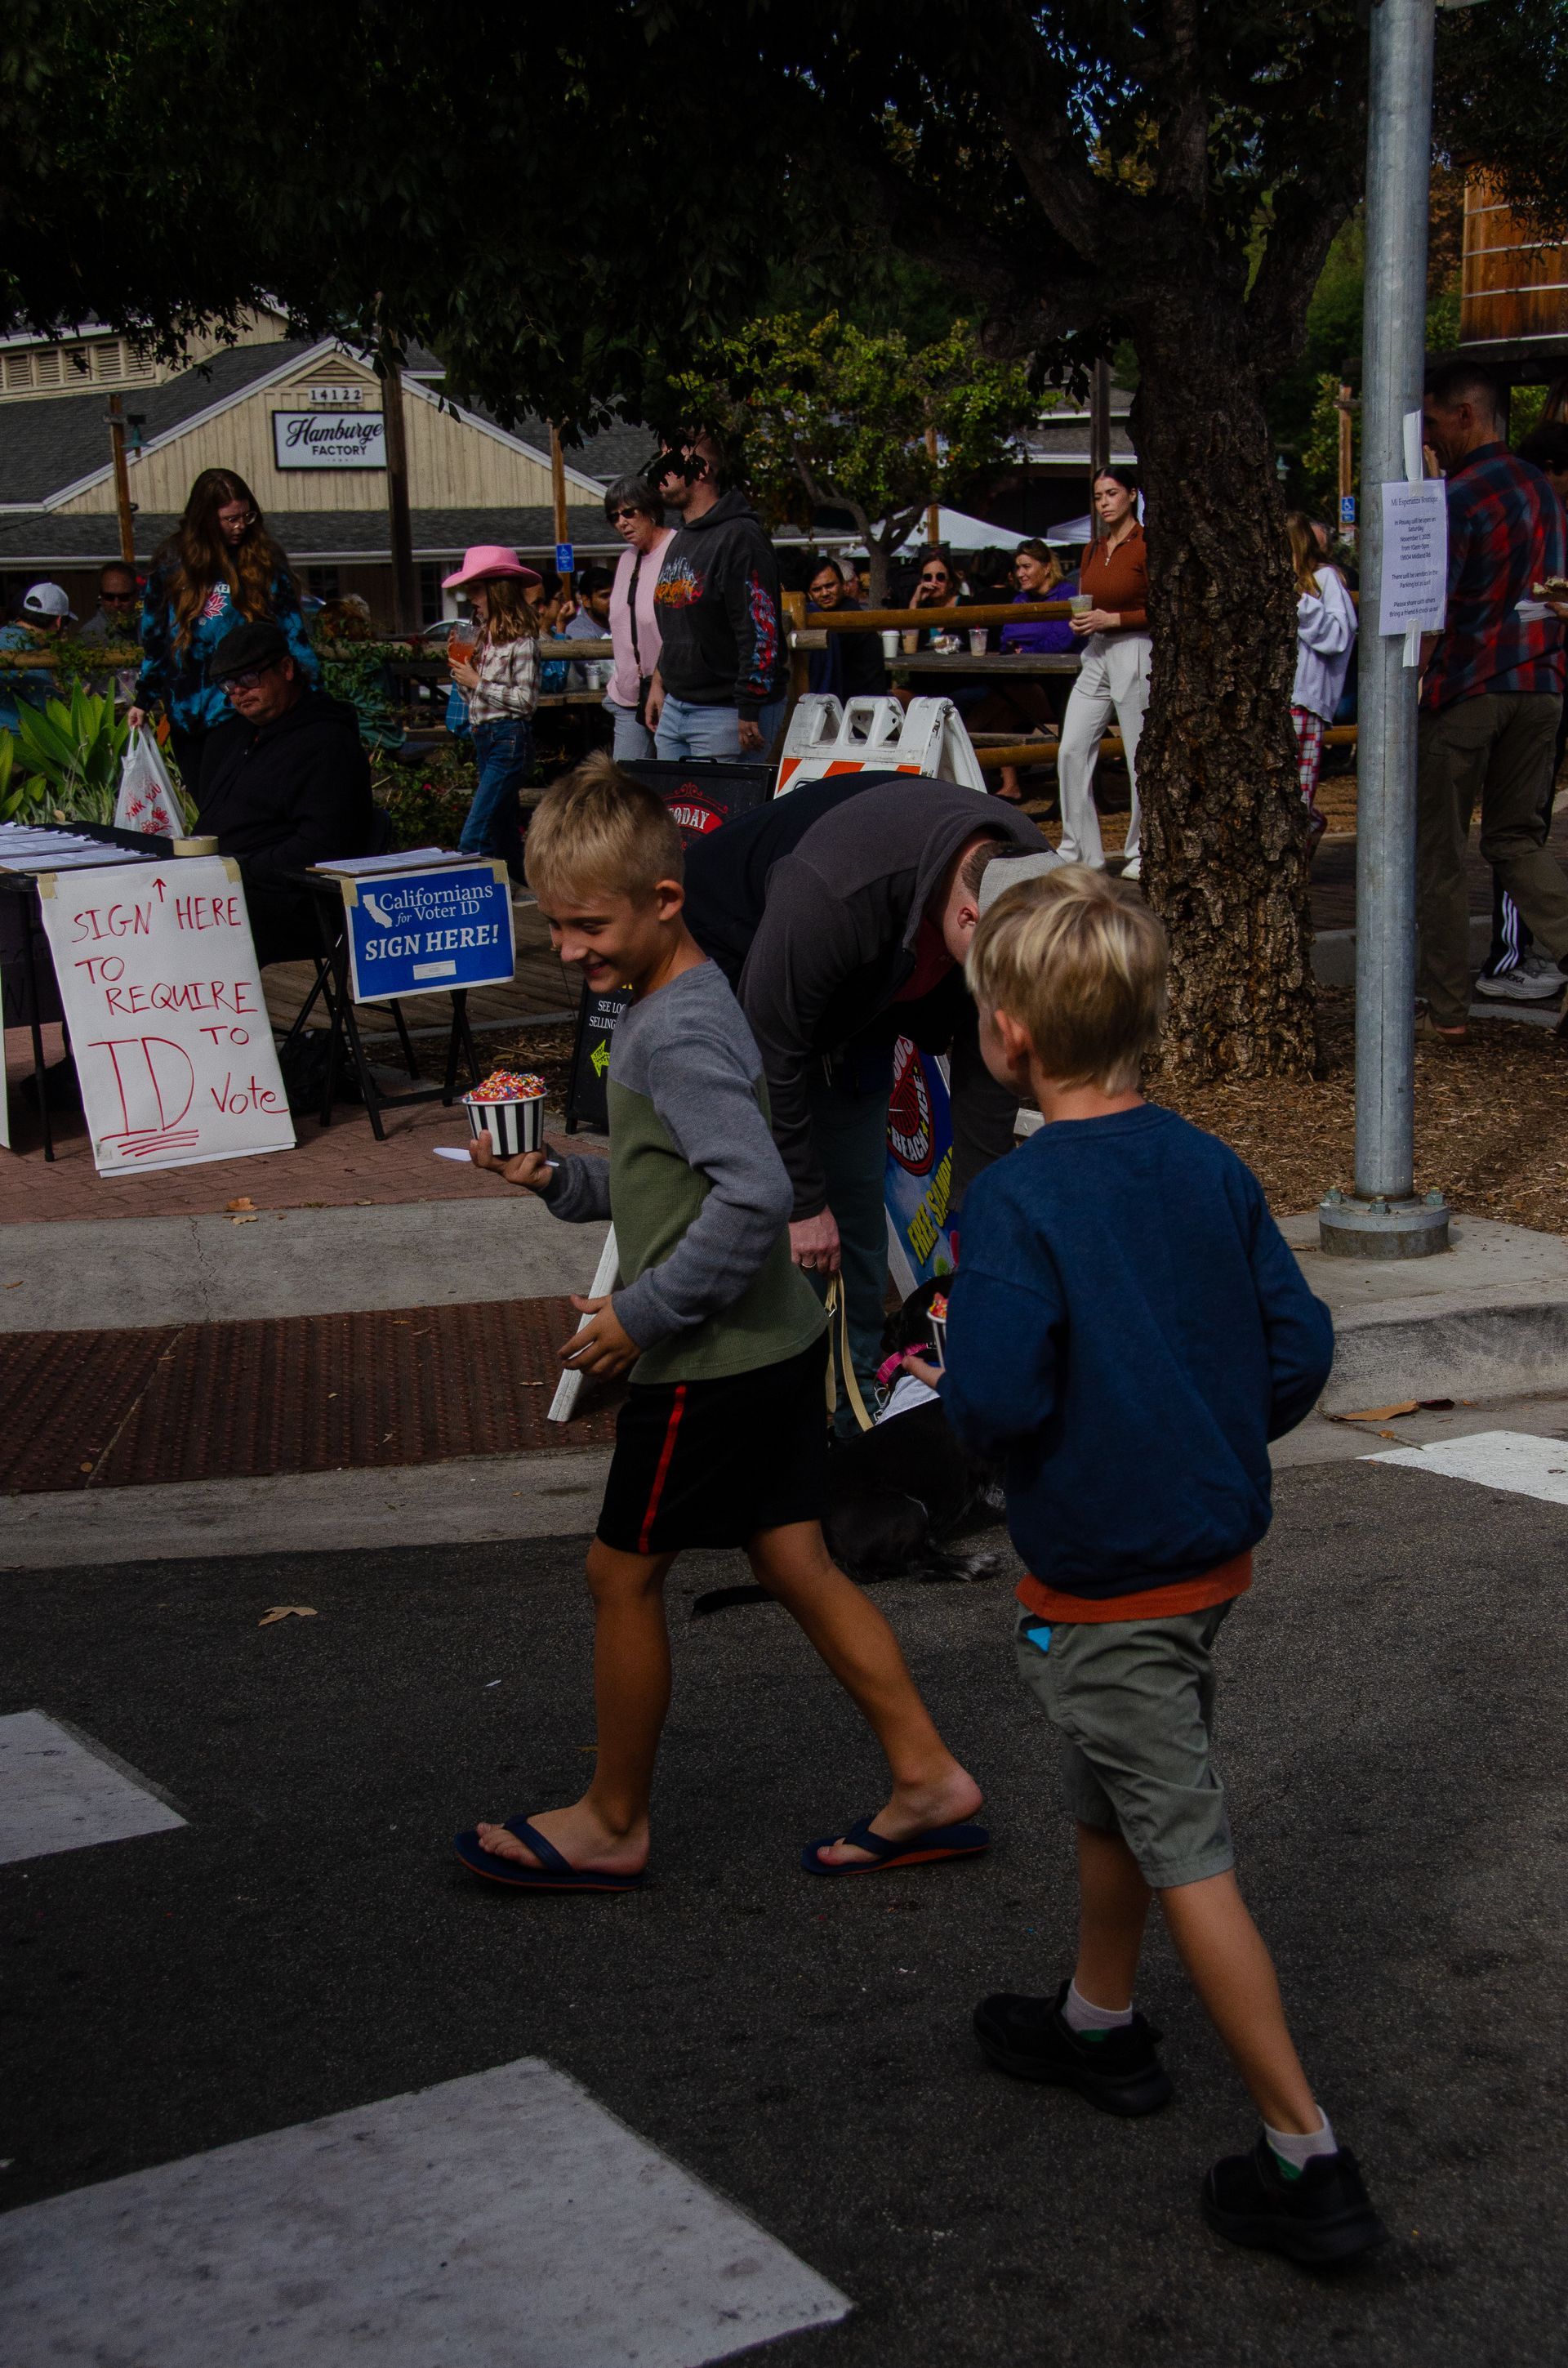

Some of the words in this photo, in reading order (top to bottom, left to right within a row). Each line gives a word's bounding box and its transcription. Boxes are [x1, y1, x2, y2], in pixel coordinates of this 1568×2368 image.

[310, 389, 362, 400] 14122
[286, 416, 385, 448] Hamburge
[312, 445, 367, 455] FACTORY
[380, 884, 493, 912] Californians
[395, 912, 412, 927] for
[414, 904, 457, 921] Voter
[461, 899, 480, 916] ID
[72, 901, 152, 943] SIGN
[176, 895, 242, 930] HERE
[365, 934, 421, 961] SIGN
[425, 924, 499, 952] HERE!
[74, 956, 125, 984] TO
[105, 981, 258, 1015] REQUIRE
[598, 1000, 612, 1013] SEE
[612, 1002, 626, 1014] LO
[199, 1026, 250, 1046] TO
[589, 1015, 617, 1030] SELLING
[88, 1037, 195, 1142] ID
[211, 1072, 289, 1114] Vote
[913, 1074, 930, 1125] ICE
[891, 1124, 929, 1163] BEACH
[906, 1202, 938, 1266] FREE
